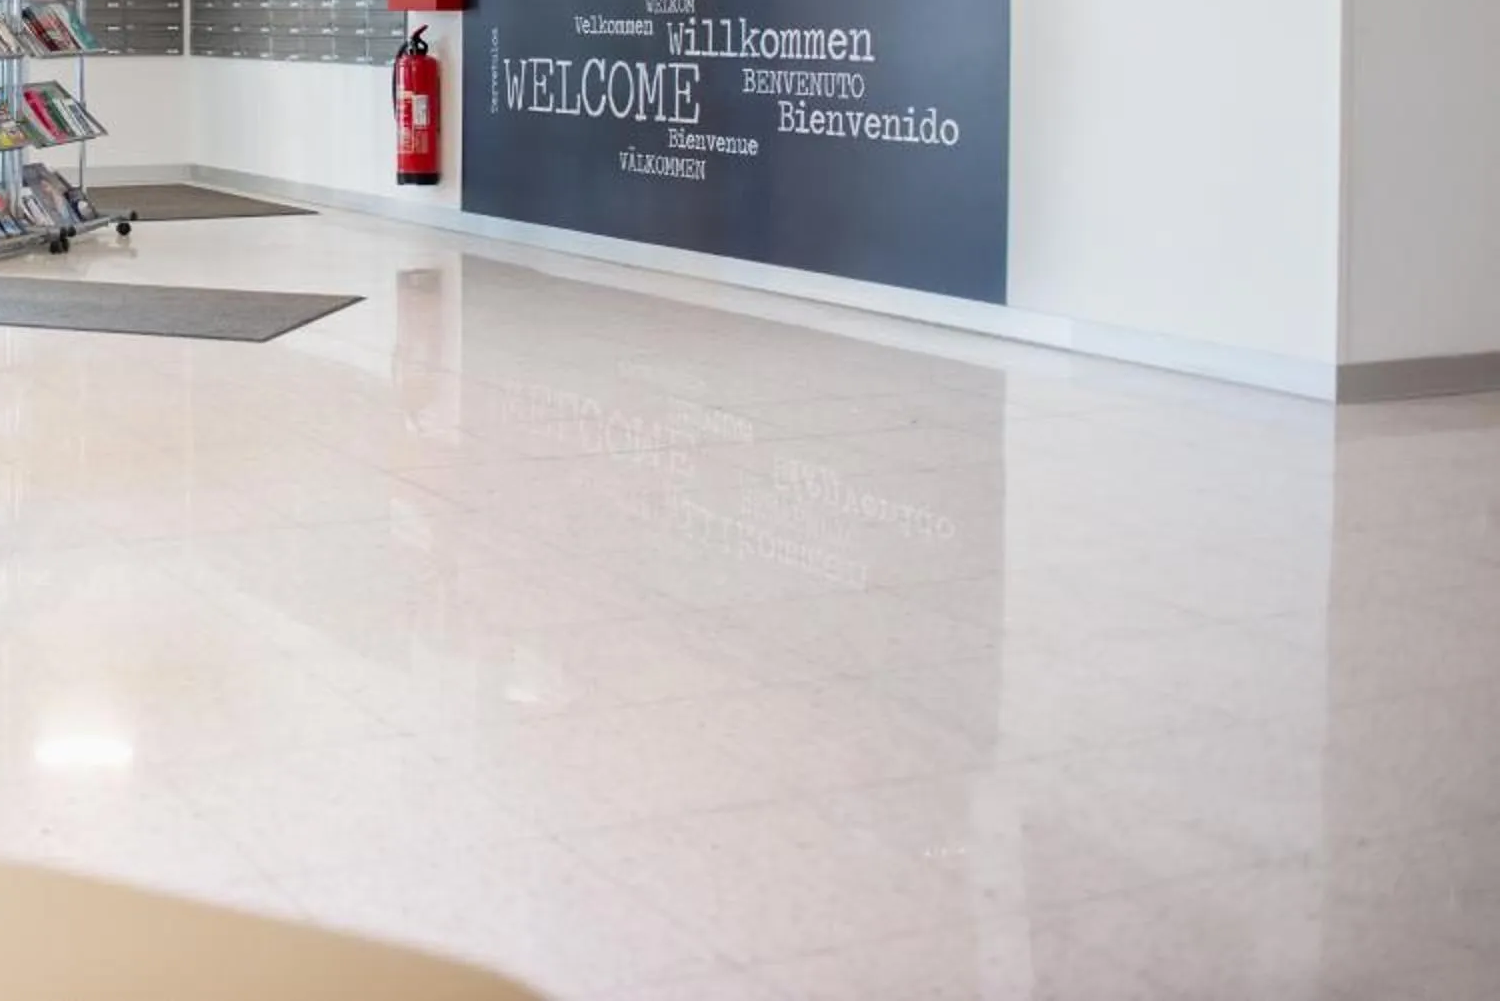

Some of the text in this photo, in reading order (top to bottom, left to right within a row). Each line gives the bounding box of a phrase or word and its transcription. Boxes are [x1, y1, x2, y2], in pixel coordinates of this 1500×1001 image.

[573, 14, 654, 36] Velkommen
[666, 17, 876, 63] Willkommen
[503, 56, 700, 125] WELCOME
[741, 67, 866, 99] BENVENUTO
[776, 99, 961, 146] Bienvenido
[667, 127, 760, 157] Bienvenue
[618, 145, 706, 180] VÄLKOMMEN
